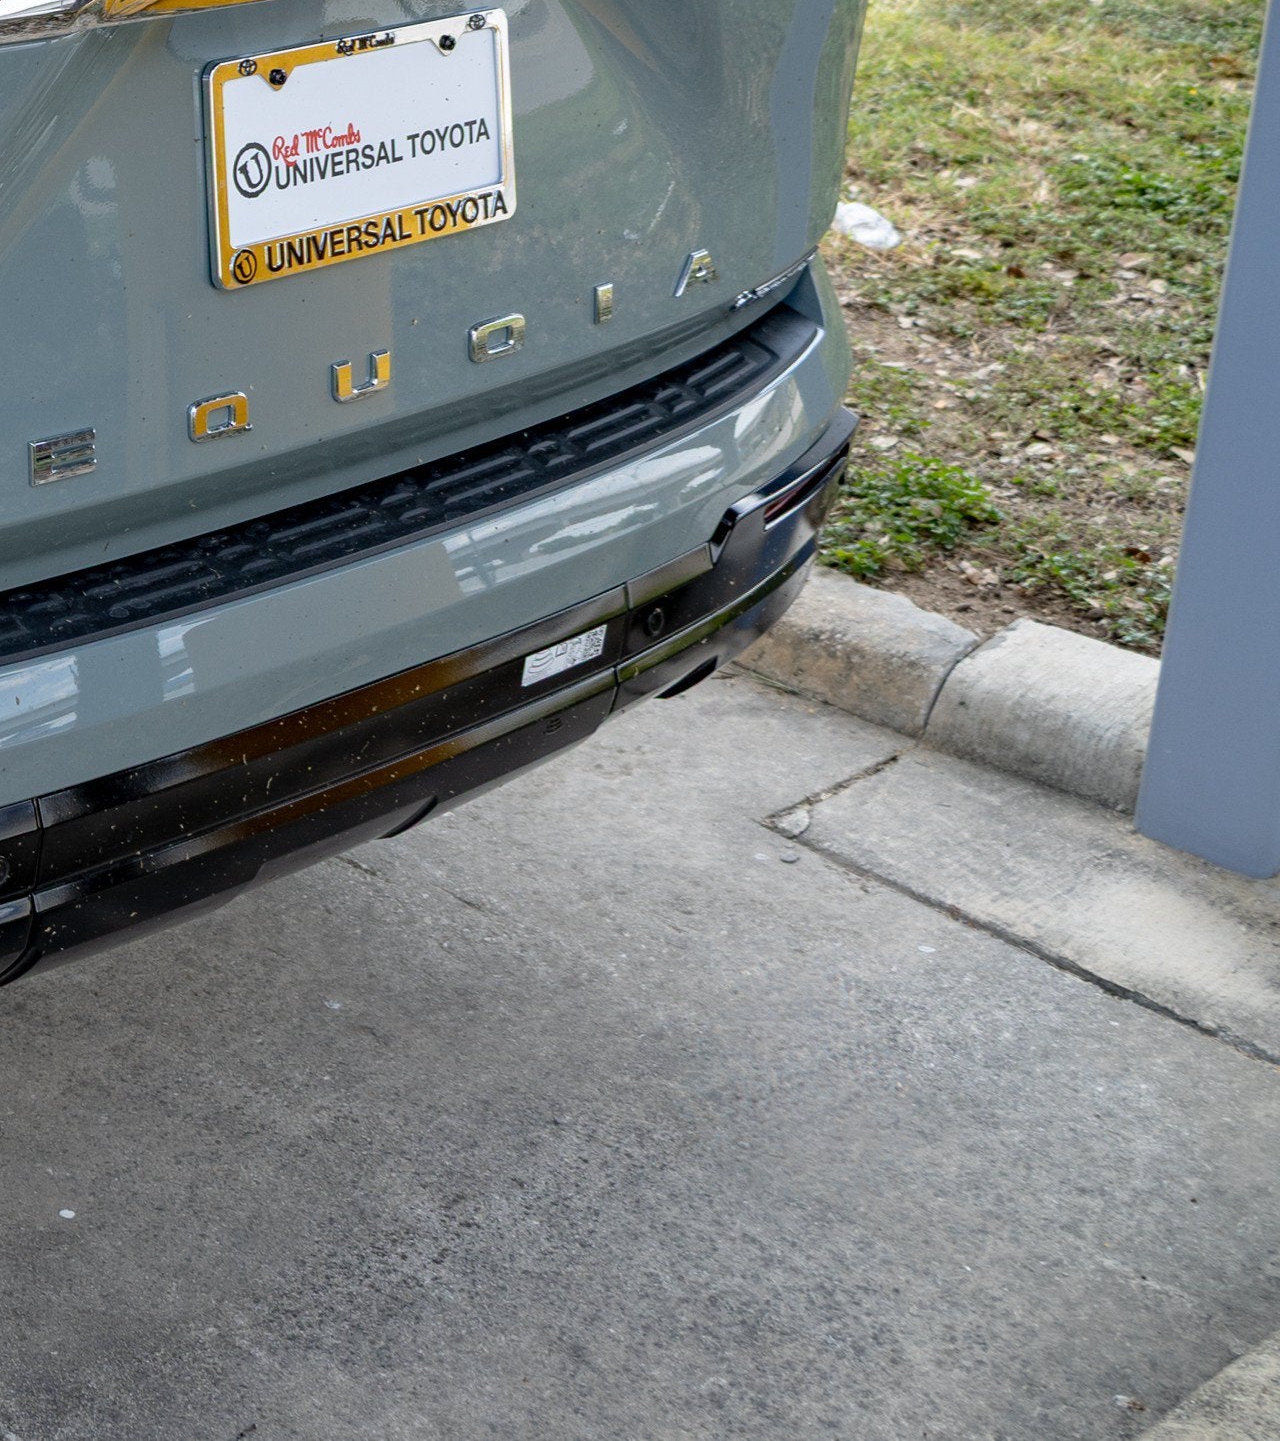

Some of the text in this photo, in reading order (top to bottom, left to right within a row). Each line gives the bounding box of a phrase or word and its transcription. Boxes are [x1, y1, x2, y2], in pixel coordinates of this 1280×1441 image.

[272, 123, 361, 167] Red McCombs
[274, 117, 491, 190] UNIVERSAL TOYOTA
[264, 216, 412, 273] UNIVERSAL
[415, 189, 509, 236] TOYOTA
